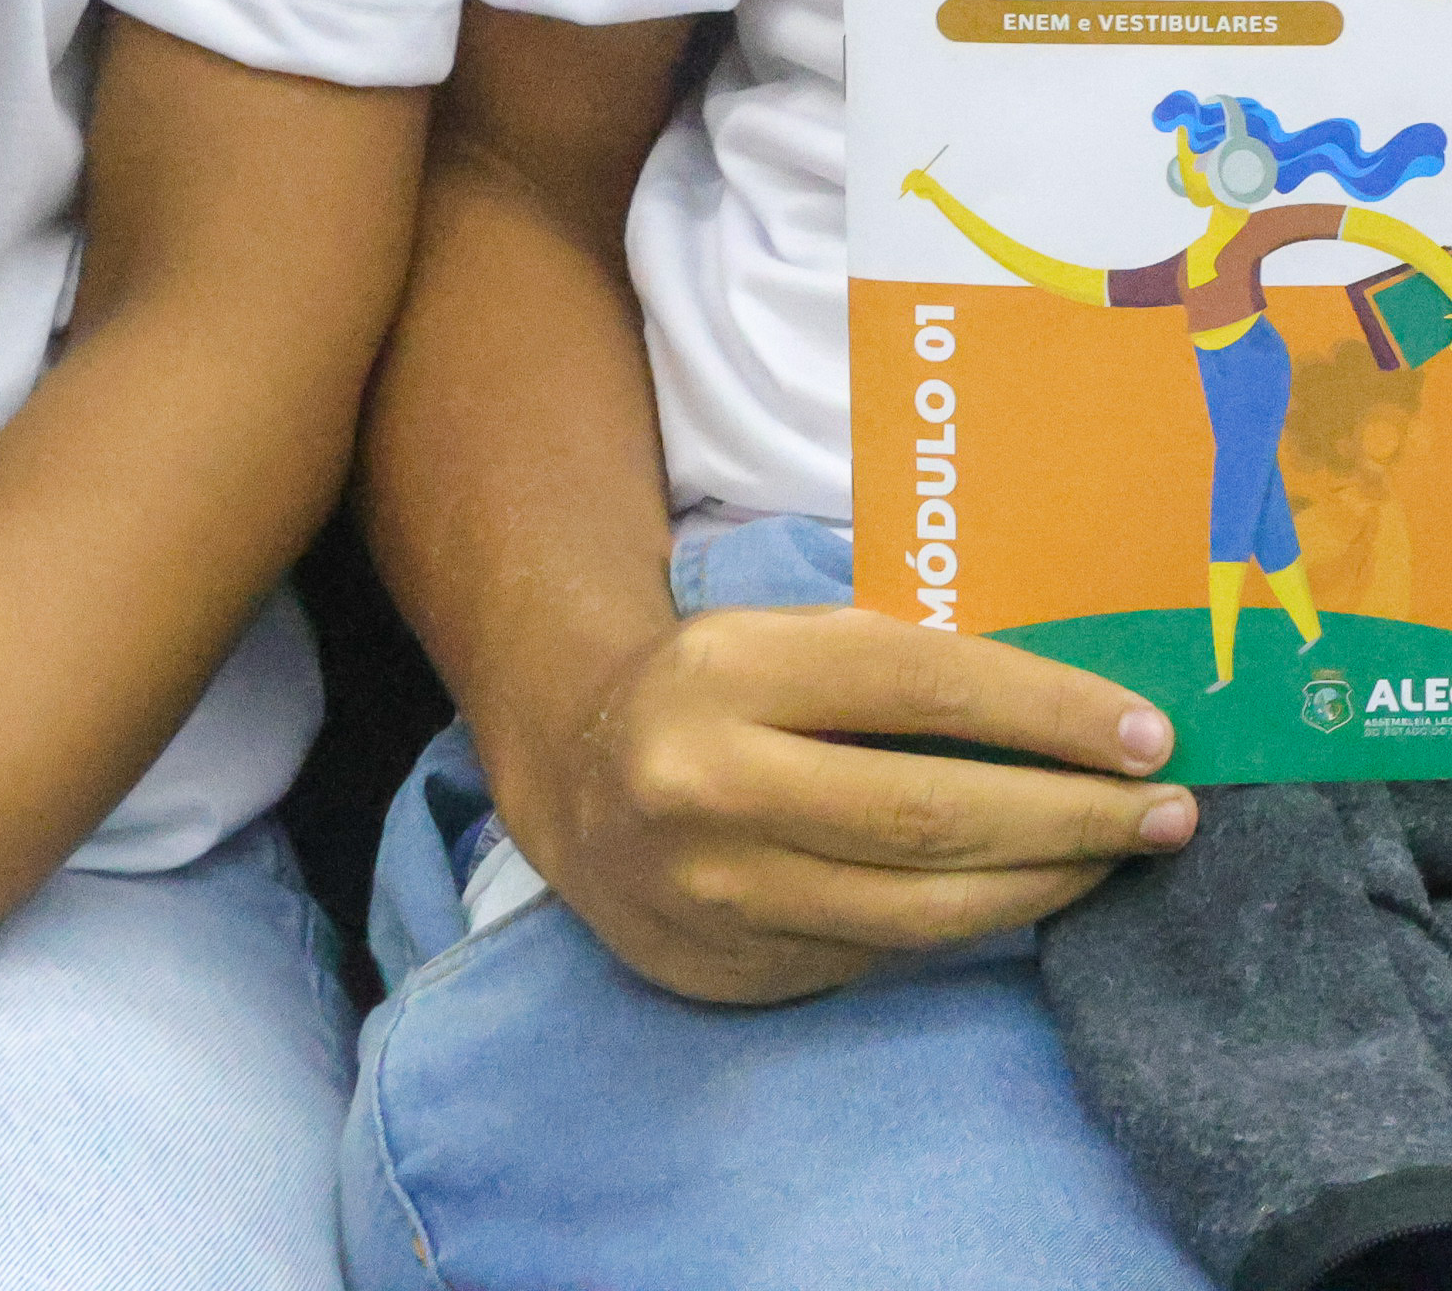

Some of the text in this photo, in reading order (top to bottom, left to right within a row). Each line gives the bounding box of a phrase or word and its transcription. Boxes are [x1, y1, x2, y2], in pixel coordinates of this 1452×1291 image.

[1003, 13, 1279, 33] ENEM e VESTIBULARES
[905, 304, 959, 633] MÓDULO 01
